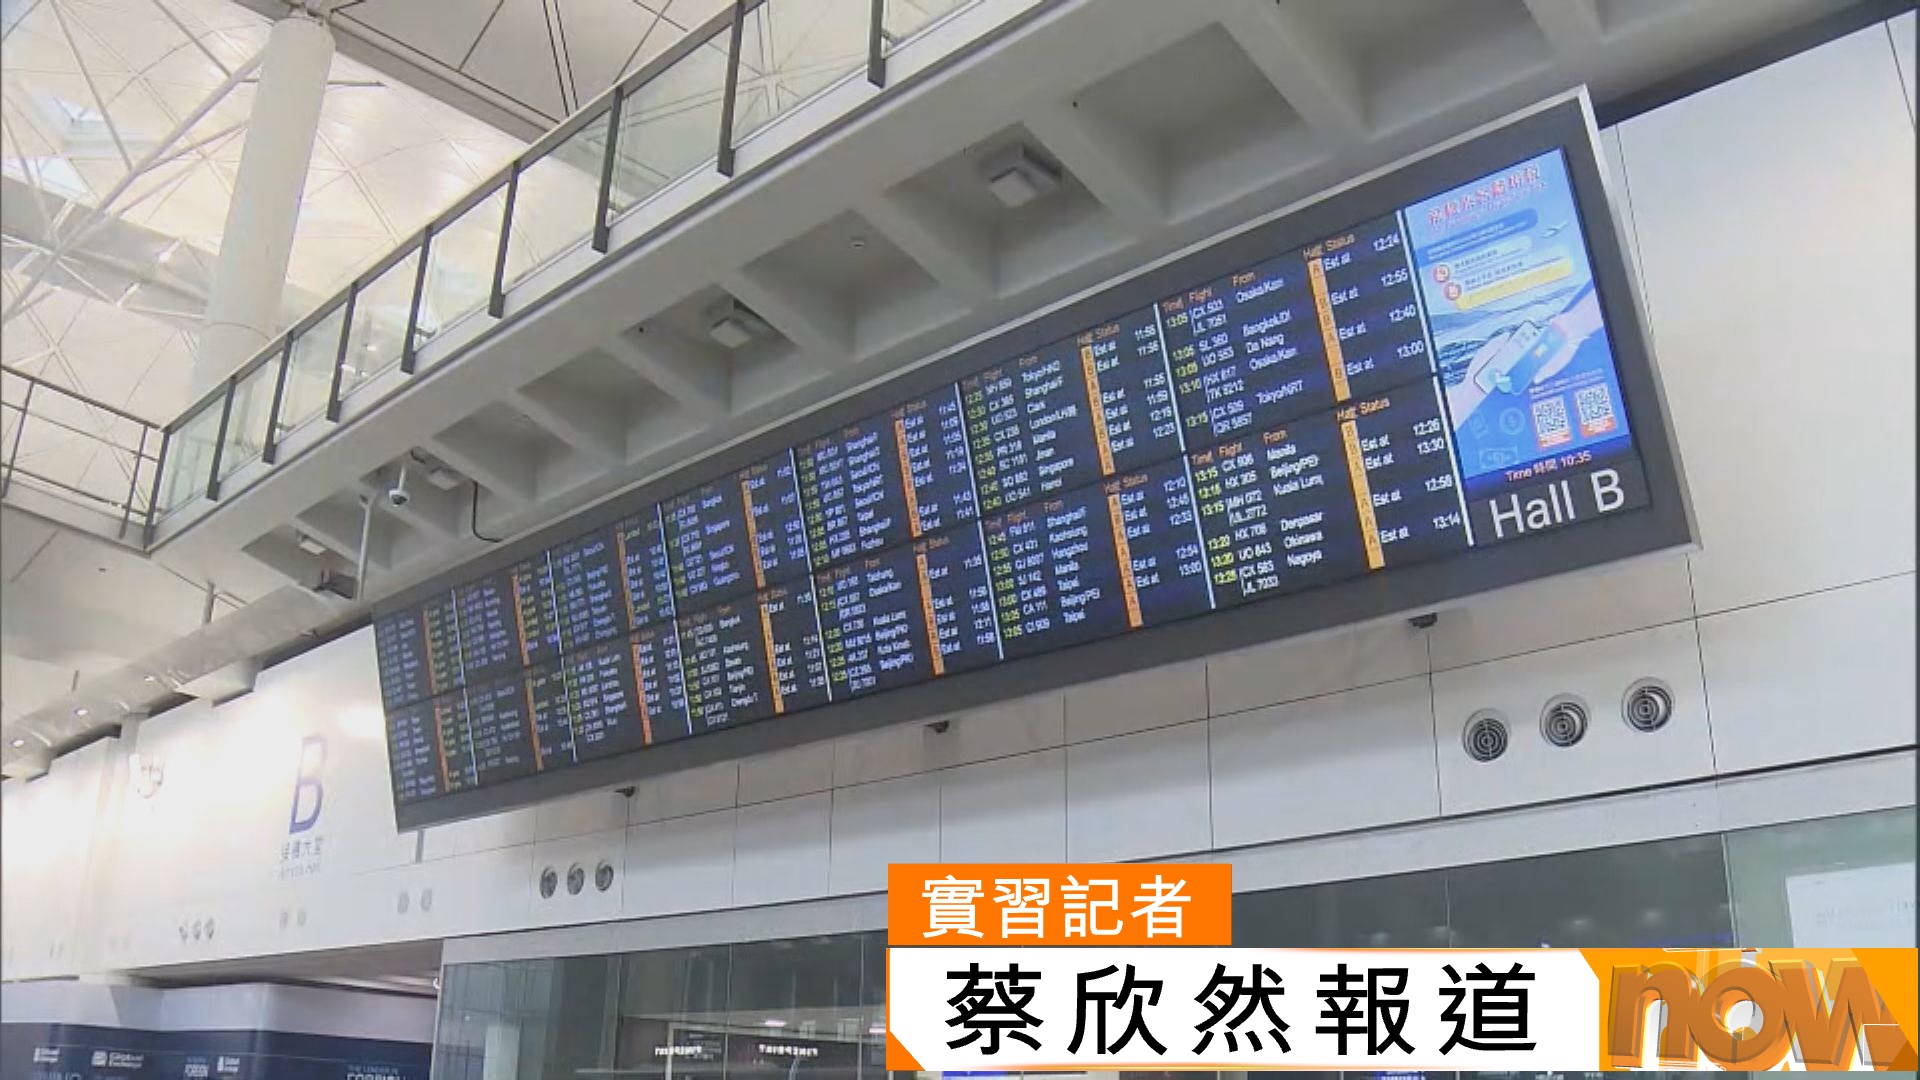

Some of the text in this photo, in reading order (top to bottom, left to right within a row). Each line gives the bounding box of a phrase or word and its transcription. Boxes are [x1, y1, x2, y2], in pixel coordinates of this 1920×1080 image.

[1322, 255, 1340, 270] Est
[1330, 290, 1347, 305] Est
[1338, 325, 1354, 339] Est
[1346, 361, 1363, 375] Est
[1396, 339, 1424, 357] 13:00
[1359, 397, 1390, 414] Status
[1360, 437, 1378, 451] Est
[1364, 455, 1382, 469] Est
[1416, 436, 1444, 454] 13:30
[1560, 450, 1592, 467] 10:35
[1194, 465, 1218, 481] 13:15
[1372, 492, 1390, 506] Est
[1489, 468, 1625, 538] Hall B
[1286, 549, 1322, 566] Nagoya
[1380, 528, 1397, 542] Est
[290, 735, 326, 834] B
